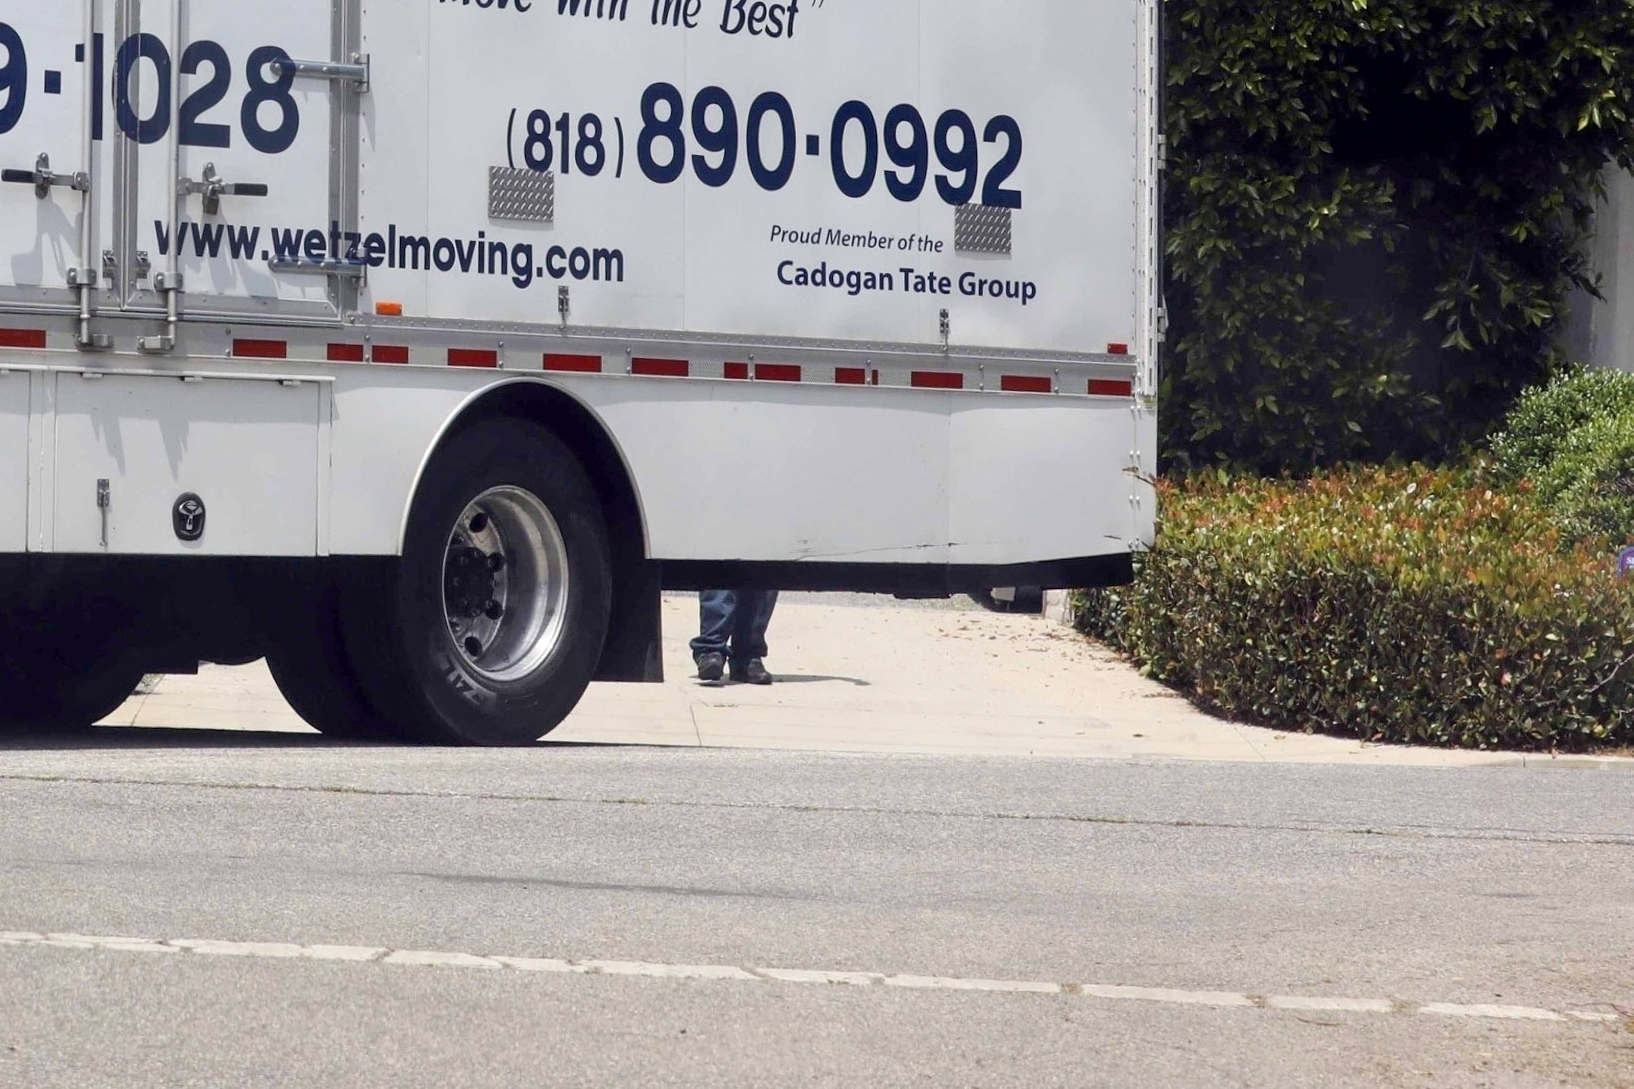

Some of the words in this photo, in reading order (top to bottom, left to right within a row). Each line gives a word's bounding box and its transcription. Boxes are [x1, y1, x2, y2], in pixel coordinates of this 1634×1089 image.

[506, 107, 625, 179] (818)
[153, 219, 625, 290] www.wetzelmoving.com
[770, 224, 822, 245] Proud
[824, 228, 894, 250] Member
[897, 232, 917, 252] of
[917, 234, 944, 253] the
[777, 260, 894, 296] Cadogan
[899, 267, 953, 295] Tate
[957, 271, 1037, 306] Group
